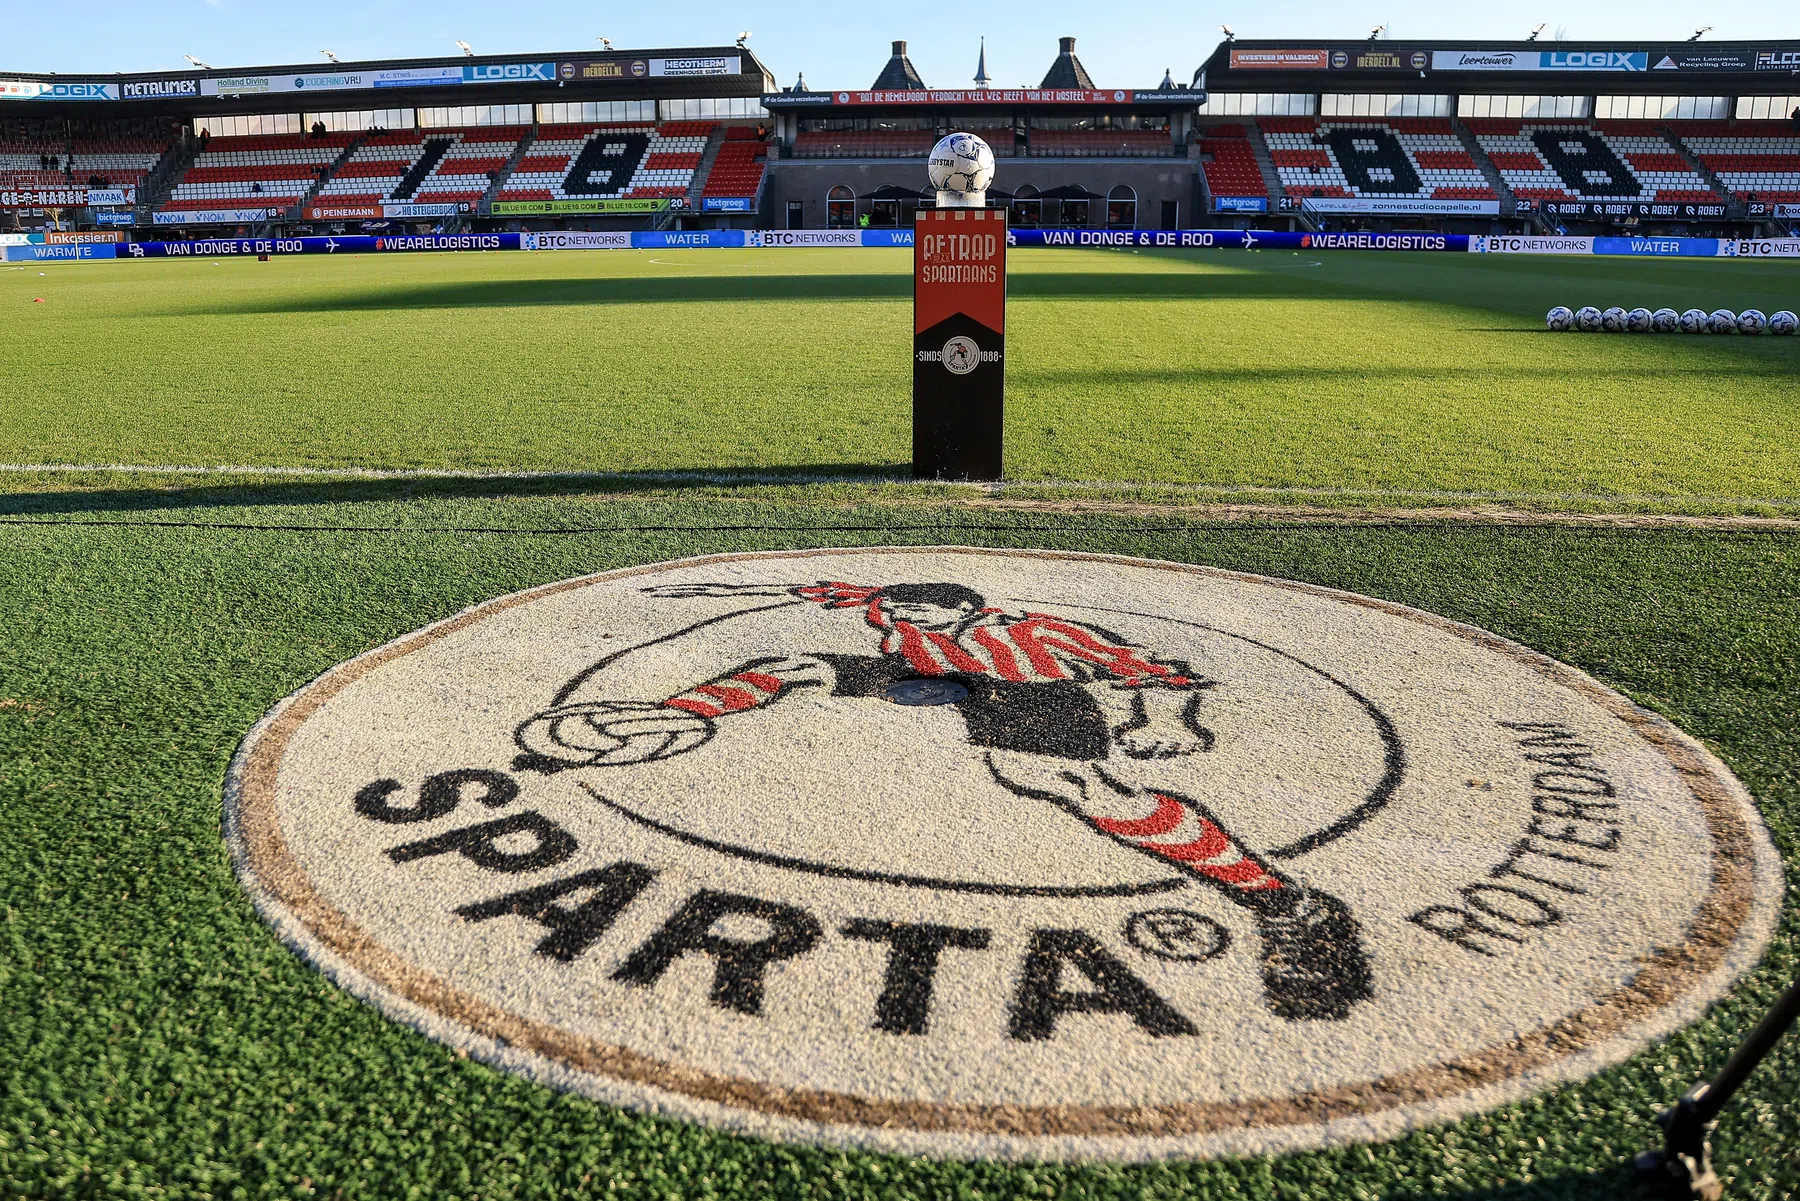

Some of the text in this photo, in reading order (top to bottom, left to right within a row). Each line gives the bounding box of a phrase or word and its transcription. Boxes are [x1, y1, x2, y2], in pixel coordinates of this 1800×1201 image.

[666, 59, 725, 69] HECOTHERM
[1459, 53, 1514, 66] Leertouwer
[1550, 52, 1635, 70] LOGIX
[472, 64, 547, 80] LOGIX
[217, 77, 269, 87] Holland Diving
[123, 80, 196, 96] METALIMEX
[795, 95, 830, 103] verzekeringen
[875, 92, 883, 102] DE
[885, 92, 928, 102] HEMELPOORT
[967, 91, 985, 101] VEEL
[986, 91, 1002, 101] WEG
[1003, 91, 1024, 101] HEEFT
[1026, 91, 1040, 101] VAN
[1041, 91, 1054, 101] HET
[1167, 93, 1204, 101] verzekeringen
[38, 191, 84, 205] NAREN
[88, 192, 123, 202] NMAAK
[1280, 198, 1292, 207] 21
[458, 203, 469, 212] 19
[502, 202, 649, 212] BLUE10.COM BLUE10.COM BLUE10.COM
[670, 198, 683, 208] 20
[707, 198, 744, 209] bictgroep
[1221, 197, 1261, 209] bictgroep
[1372, 203, 1481, 212] zonnestudiocapelle.nl
[1517, 200, 1530, 211] 22
[1750, 204, 1764, 213] 23
[266, 208, 277, 217] 18
[323, 208, 374, 217] PEINEMANN
[1560, 204, 1725, 216] ROBEY ROBEY ROBEY ROBEY
[99, 212, 132, 222] bictgroep
[0, 234, 32, 245] GIX
[376, 236, 499, 250] #WEARELOGISTICS
[539, 235, 626, 247] BTC NETWORKS
[665, 234, 710, 244] WATER
[764, 233, 856, 244] BTC NETWORKS
[1043, 231, 1213, 246] VAN DONGE & DE ROO
[1301, 234, 1446, 249] #WEARELOGISTICS
[1489, 238, 1587, 250] BTC NETWORKS
[33, 246, 92, 258] WARMTE
[164, 240, 303, 255] VAN DONGE & DE ROO
[923, 234, 996, 261] AFTRAP
[1631, 241, 1680, 252] WATER
[1739, 242, 1772, 254] BTC
[922, 264, 997, 283] SPARTAANS
[918, 350, 942, 362] SINDS
[980, 350, 999, 362] 1888
[1405, 720, 1622, 958] ROTTERDAM
[354, 768, 1199, 1042] SPARTA
